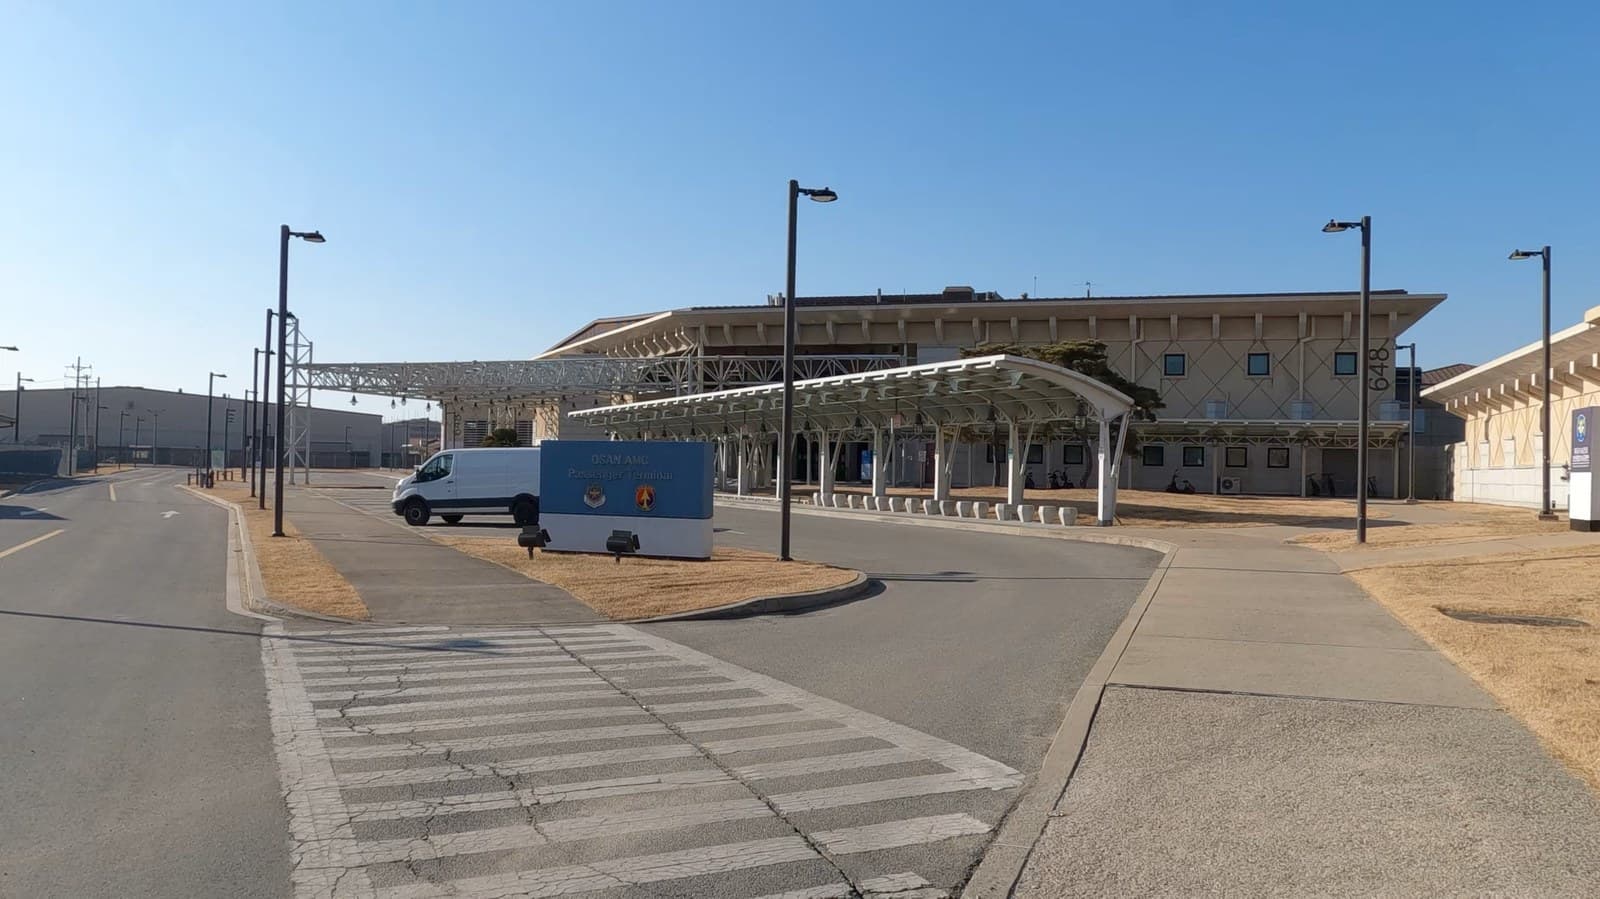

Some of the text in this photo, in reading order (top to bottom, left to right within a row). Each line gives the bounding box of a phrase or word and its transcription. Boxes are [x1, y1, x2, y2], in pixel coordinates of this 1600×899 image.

[1369, 348, 1389, 391] 648
[591, 454, 622, 465] OSAN
[567, 468, 673, 481] Passenger Terminal
